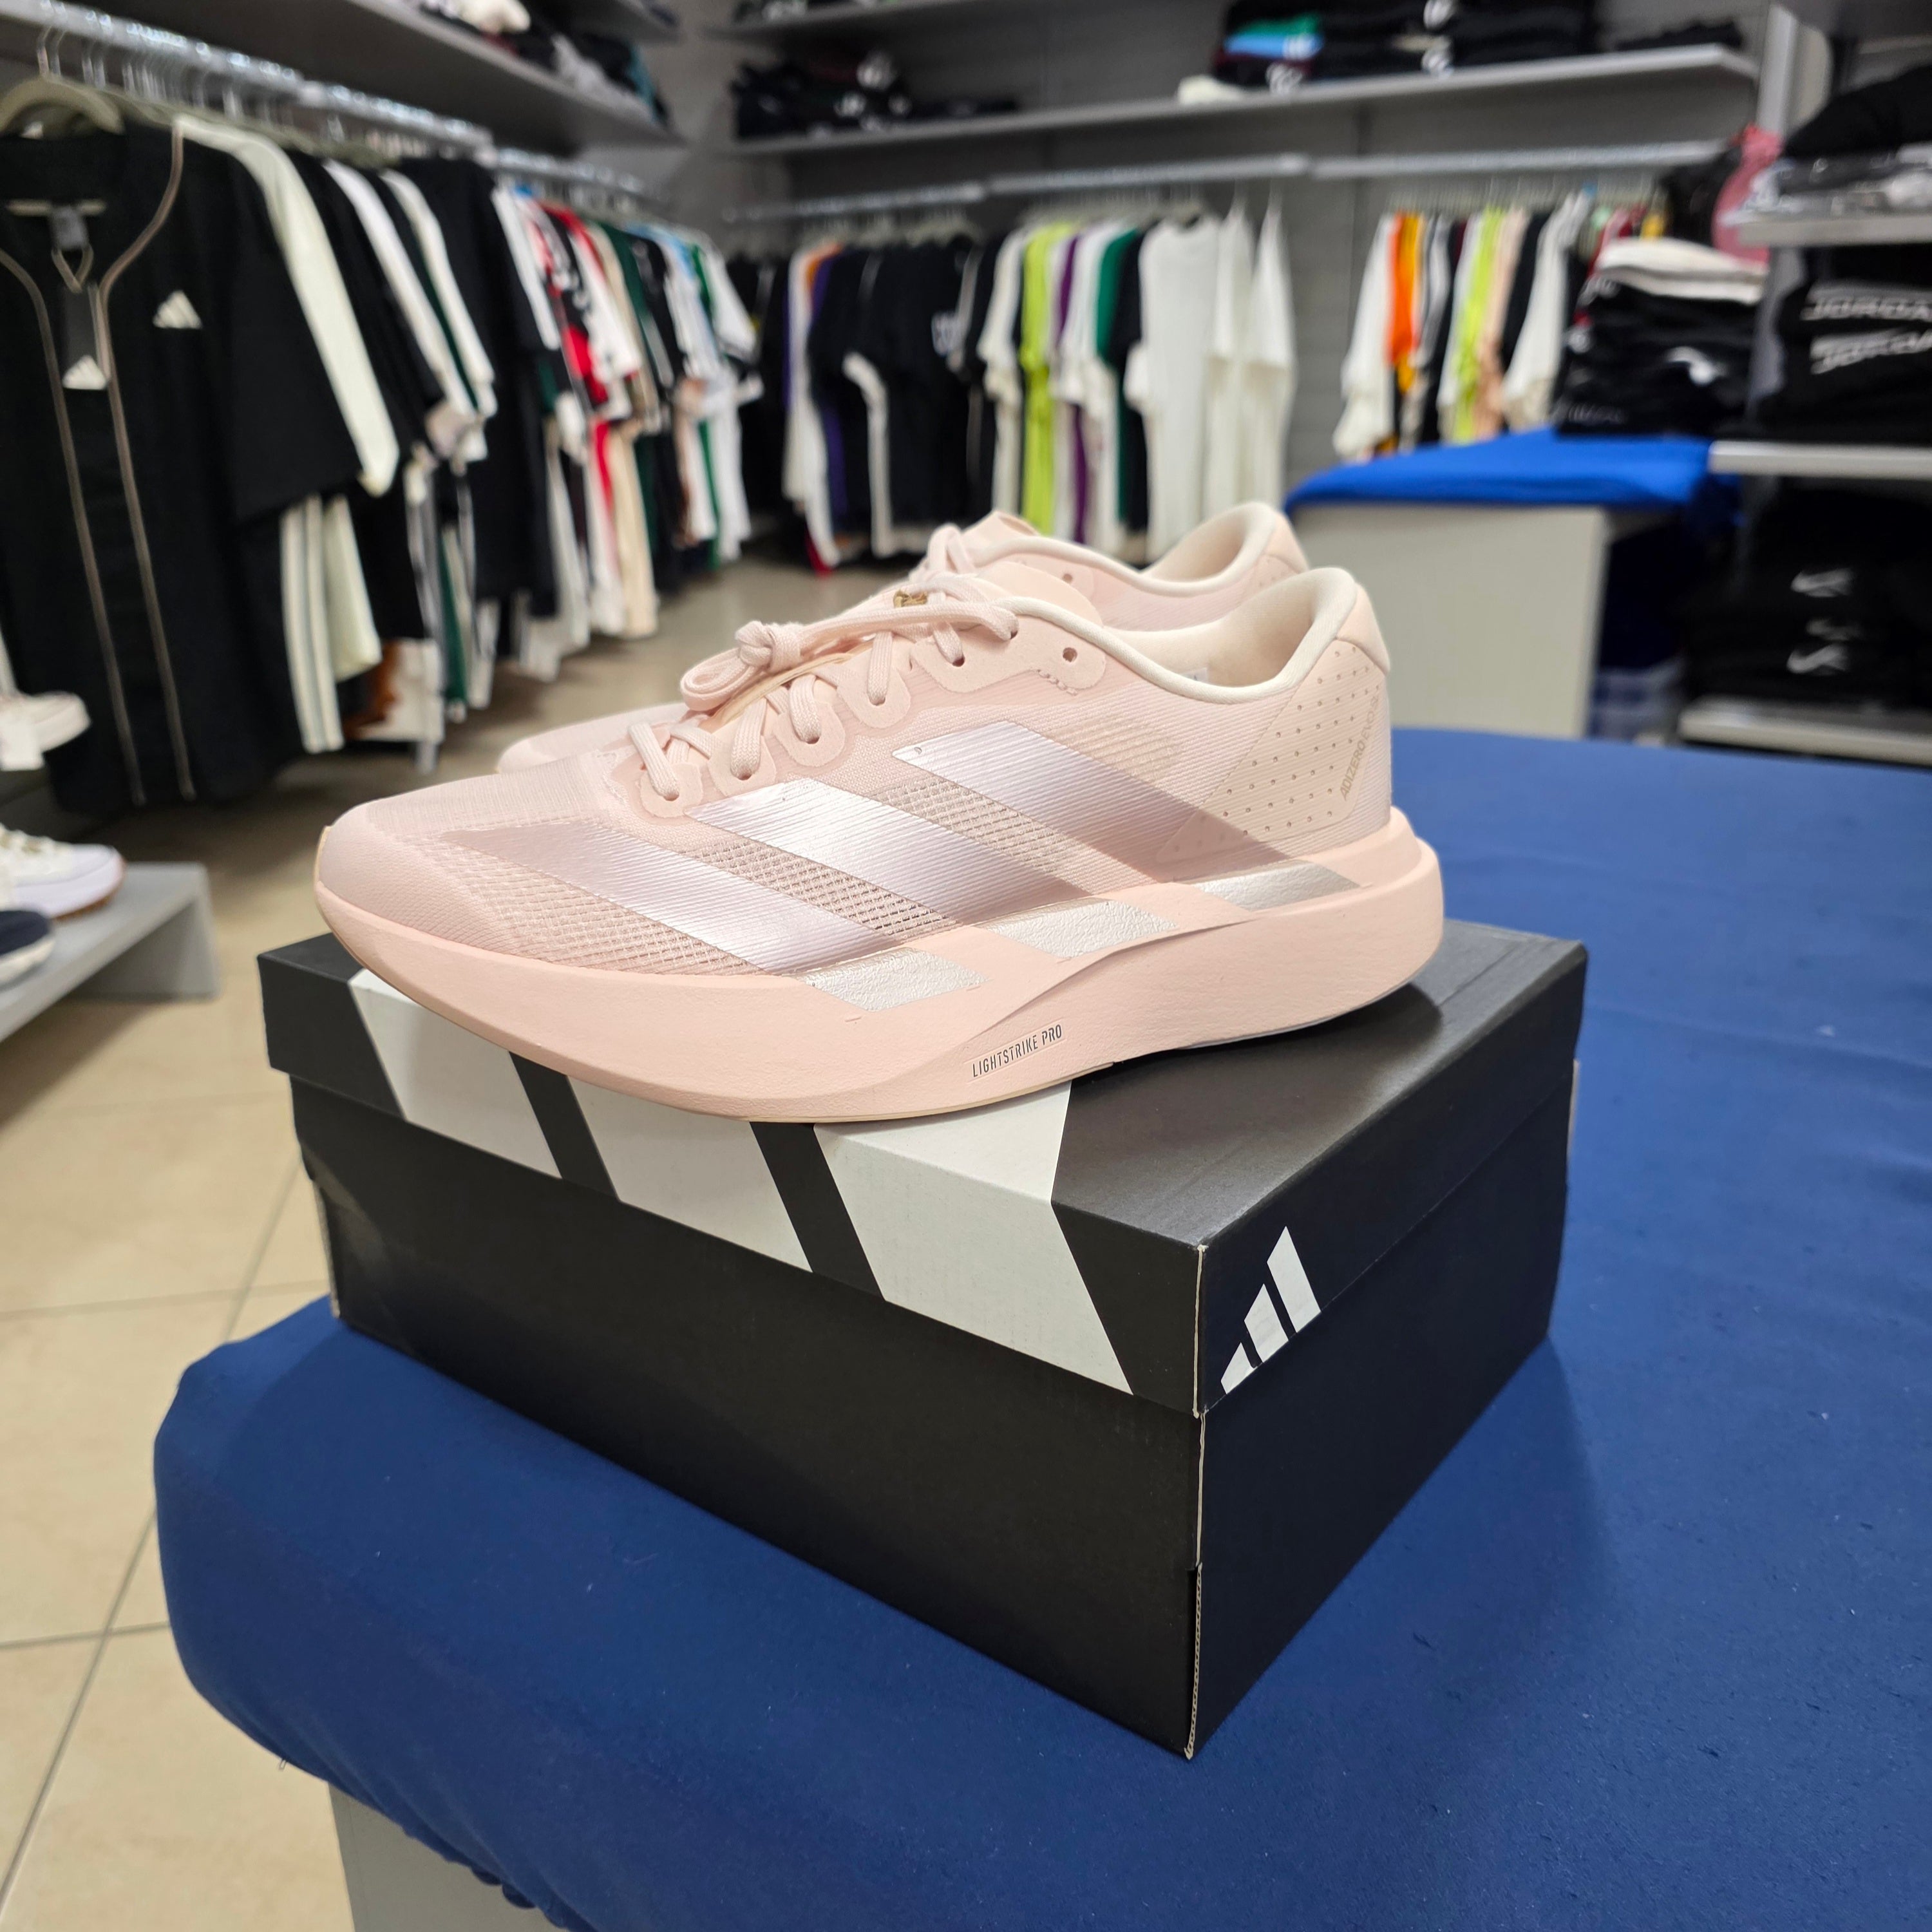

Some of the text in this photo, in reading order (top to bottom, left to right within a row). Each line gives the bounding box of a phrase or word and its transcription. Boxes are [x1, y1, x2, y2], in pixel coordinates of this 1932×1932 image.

[1340, 740, 1366, 801] ADIZERO
[972, 1024, 1062, 1077] LIGHTSTRIKE PRO
